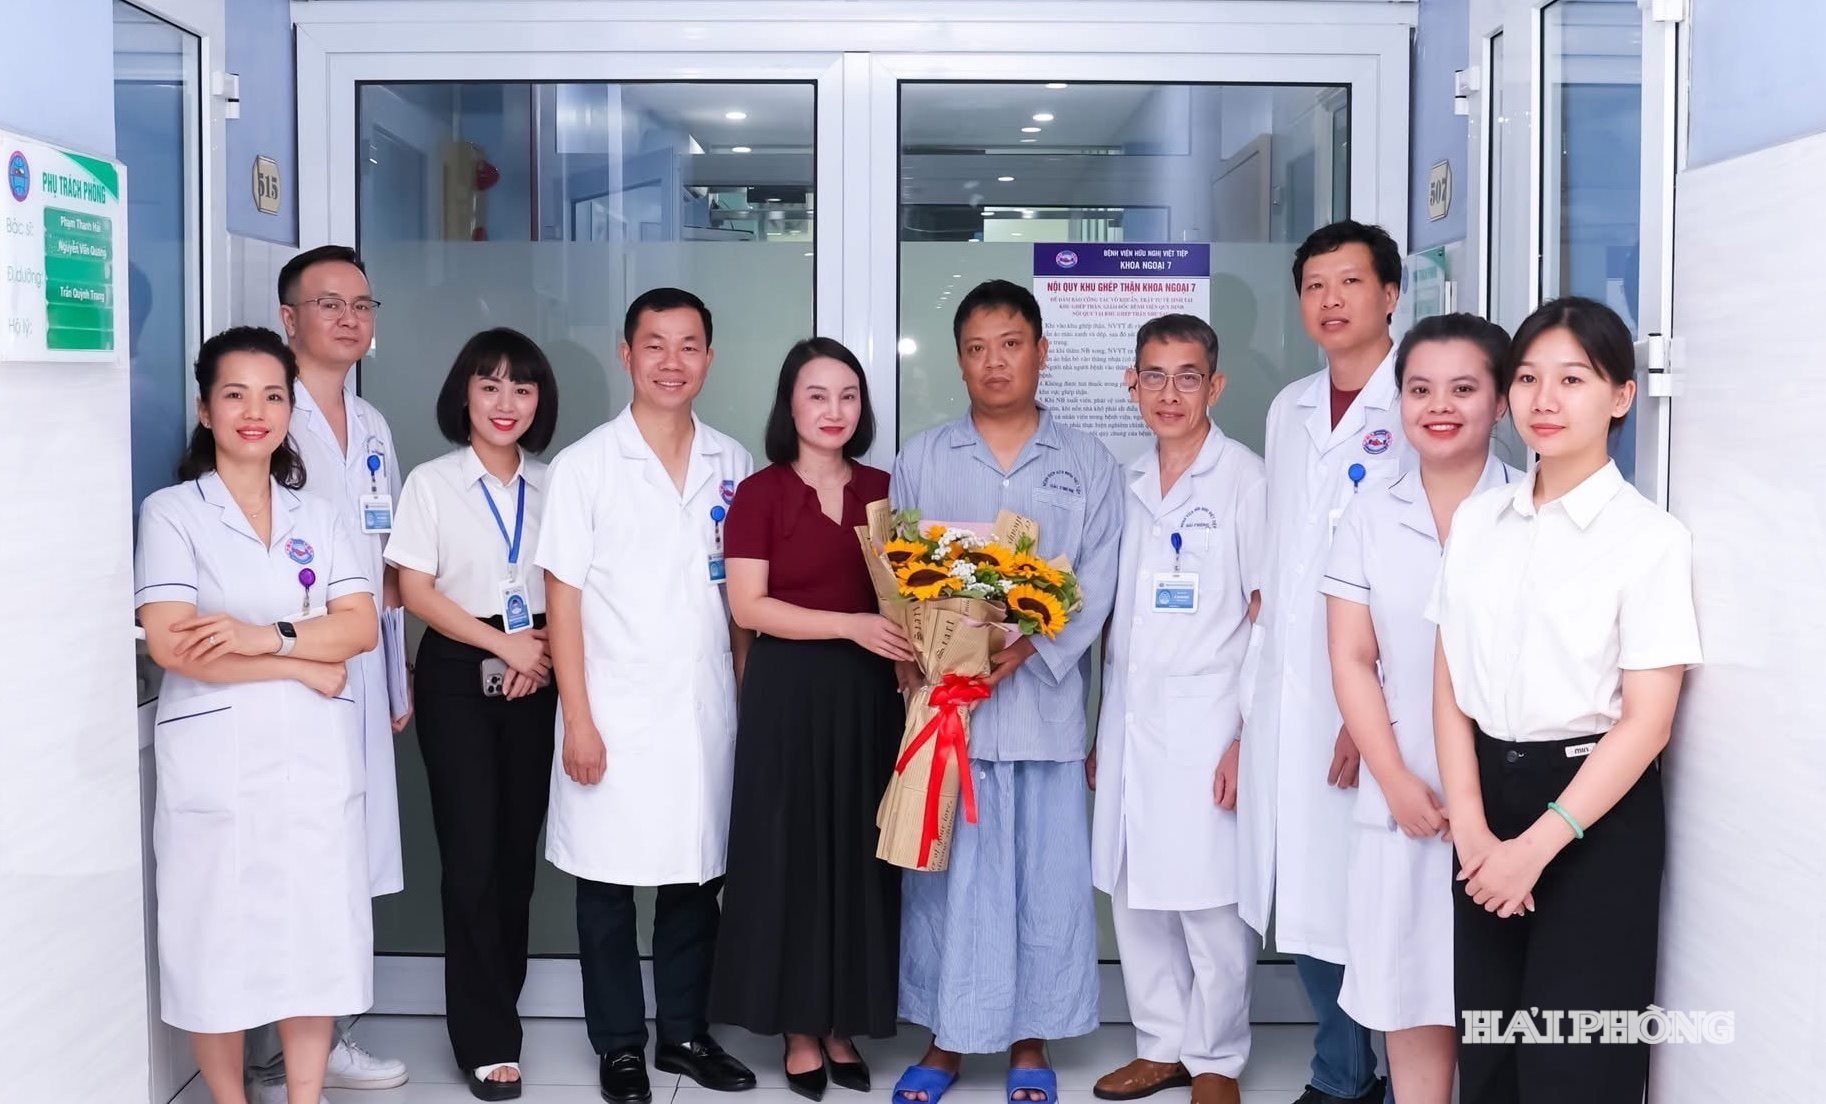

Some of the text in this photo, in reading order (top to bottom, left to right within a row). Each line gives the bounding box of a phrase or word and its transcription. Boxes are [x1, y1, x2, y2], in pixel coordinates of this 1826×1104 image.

[42, 172, 106, 204] PHỤ TRÁCH PHÒNG
[258, 173, 278, 200] 515
[1430, 178, 1447, 206] 507
[1120, 262, 1172, 270] KHOA NGOẠI 7
[1048, 280, 1196, 294] NỘI QUY KHU GHÉP THẬN KHOA NGOẠI 7
